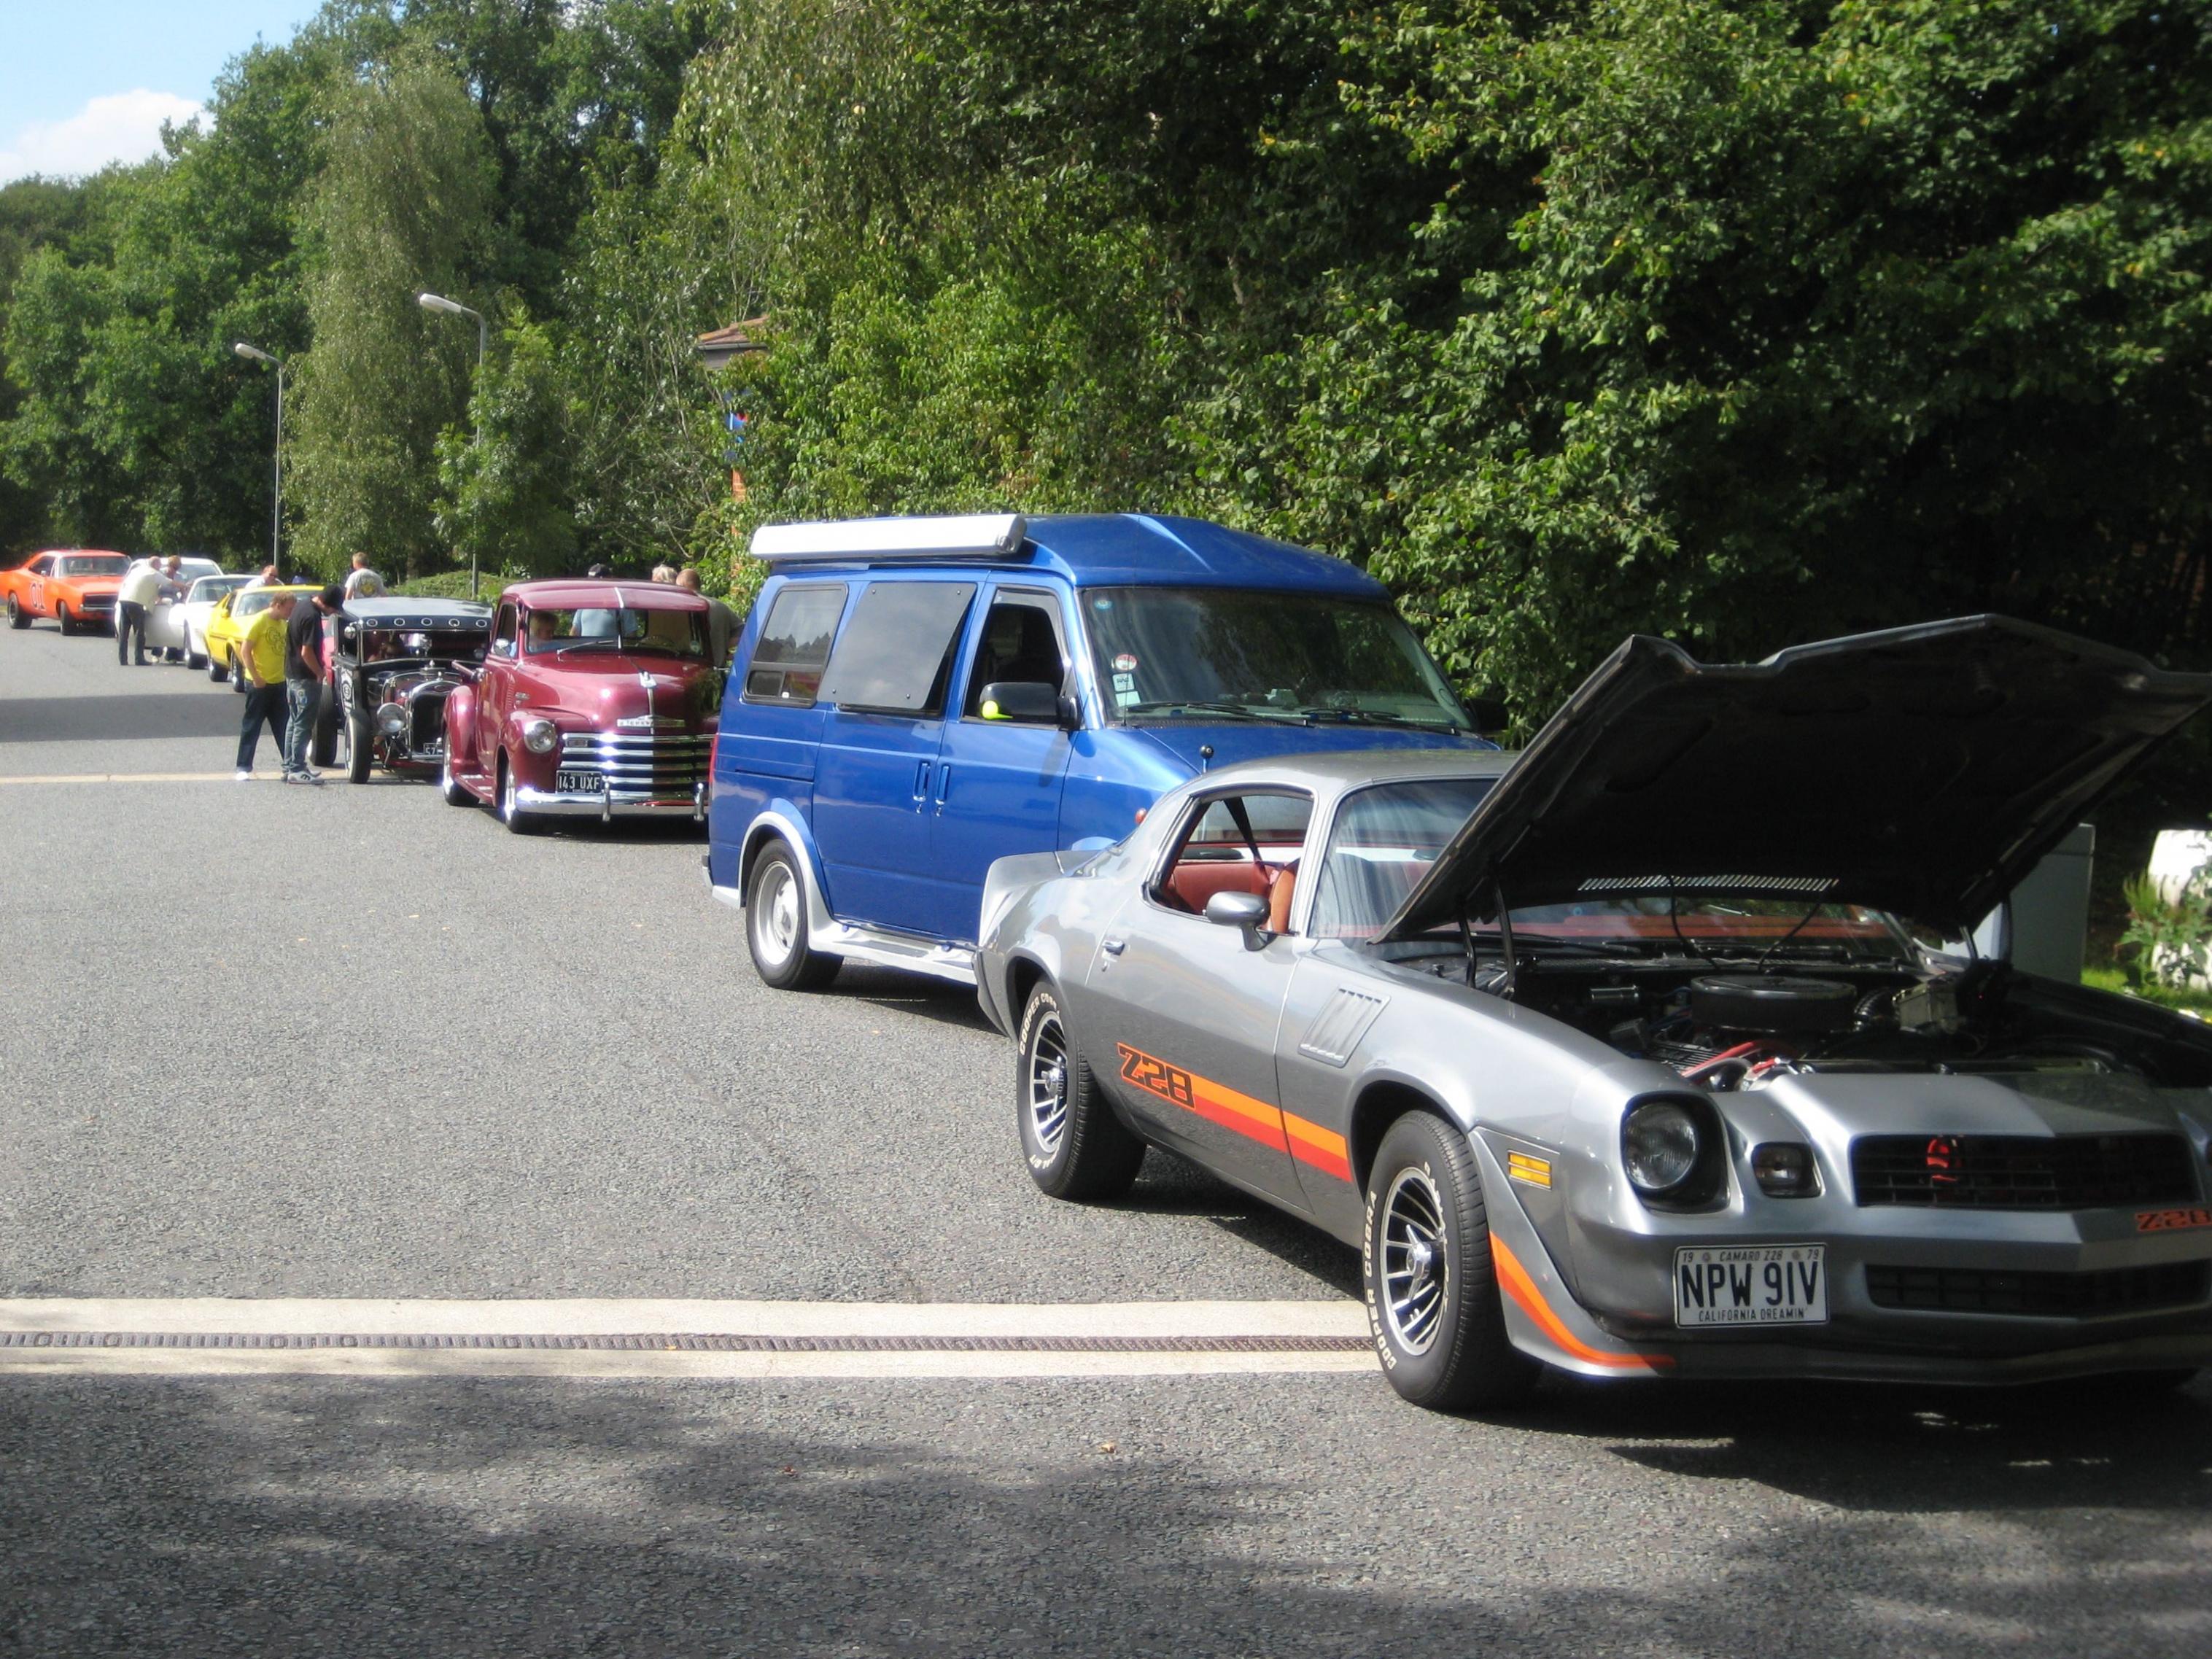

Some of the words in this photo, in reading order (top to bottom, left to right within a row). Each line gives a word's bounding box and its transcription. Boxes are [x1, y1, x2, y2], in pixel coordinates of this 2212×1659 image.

[559, 776, 575, 789] 143
[580, 777, 600, 790] UXF
[1020, 996, 1040, 1056] COOPER
[1117, 1042, 1196, 1111] Z28
[1365, 1190, 1378, 1277] COBRA
[2136, 1210, 2212, 1231] Z28
[1683, 1252, 1693, 1262] 19
[1720, 1251, 1760, 1262] CAMARO
[1763, 1250, 1783, 1261] Z28
[1807, 1249, 1819, 1259] 79
[1681, 1263, 1752, 1308] NPW
[1367, 1289, 1397, 1369] COOPER
[1699, 1310, 1756, 1321] CALIFORNIA
